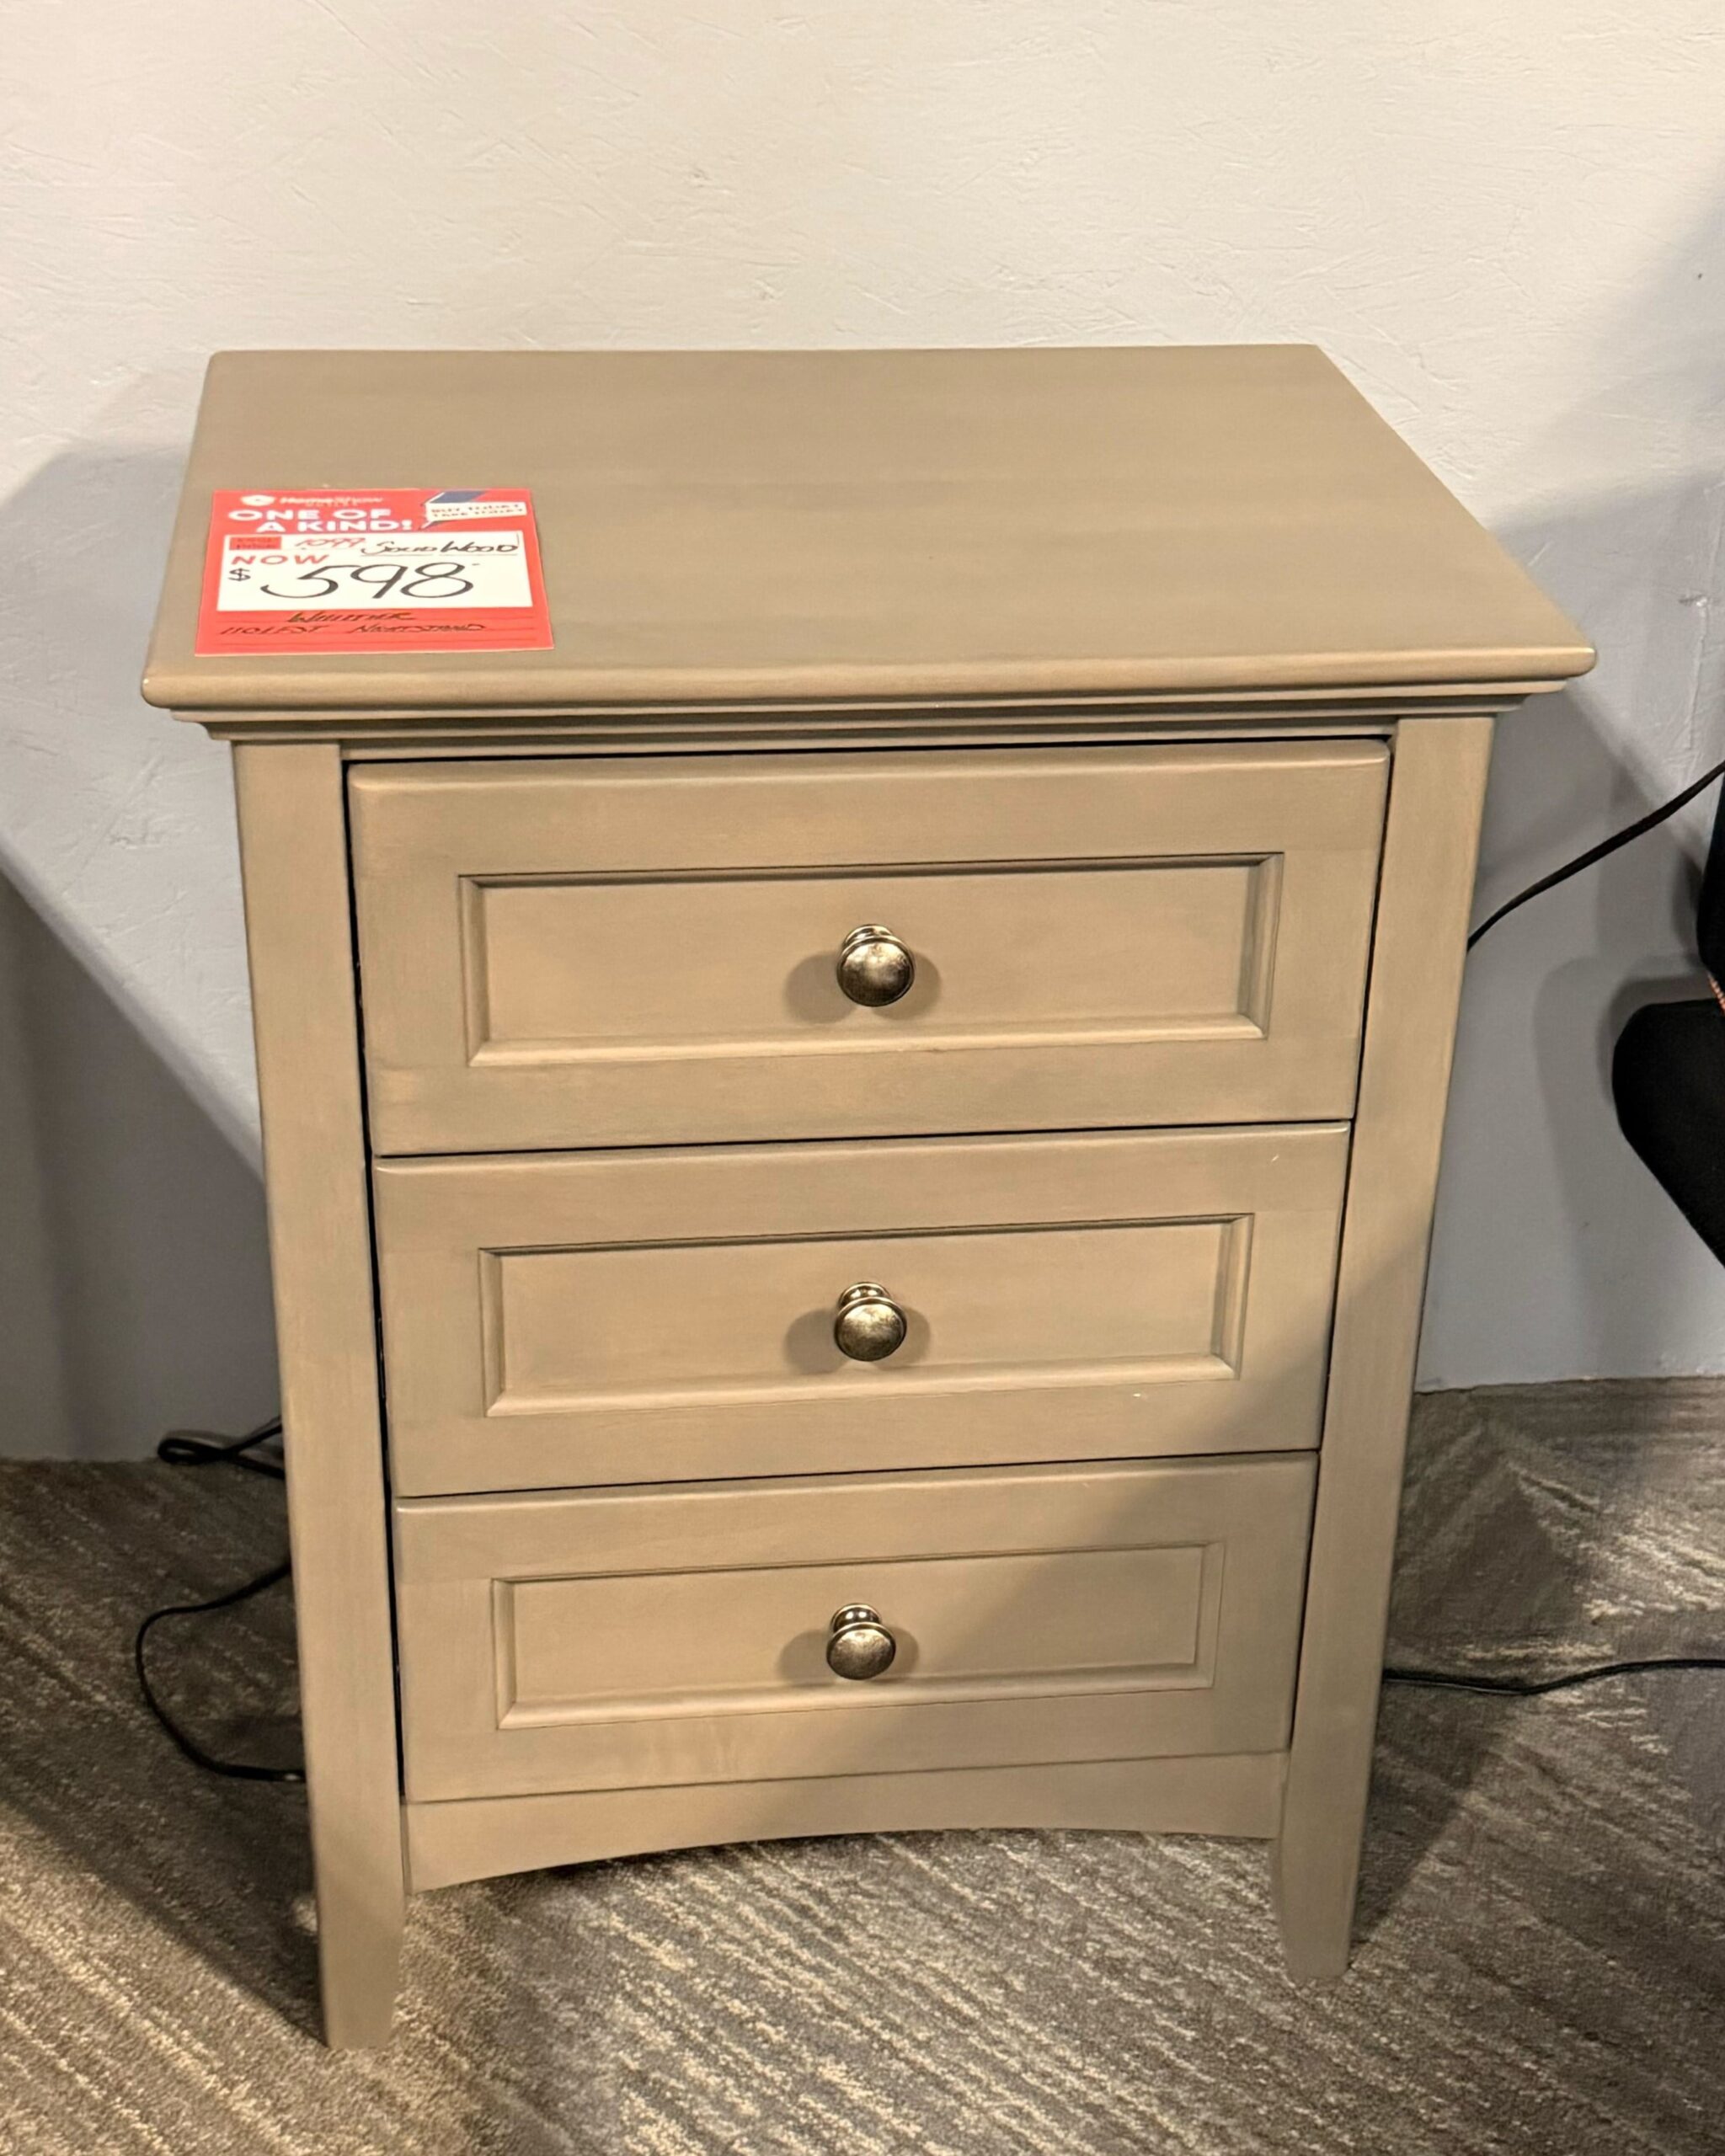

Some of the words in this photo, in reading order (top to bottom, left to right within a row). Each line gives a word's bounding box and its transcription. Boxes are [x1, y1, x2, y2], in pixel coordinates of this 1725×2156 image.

[228, 510, 320, 520] ONE
[333, 509, 392, 520] OF
[256, 521, 286, 532] A
[297, 520, 413, 531] KIND!
[231, 555, 329, 565] NOW
[227, 568, 251, 582] $
